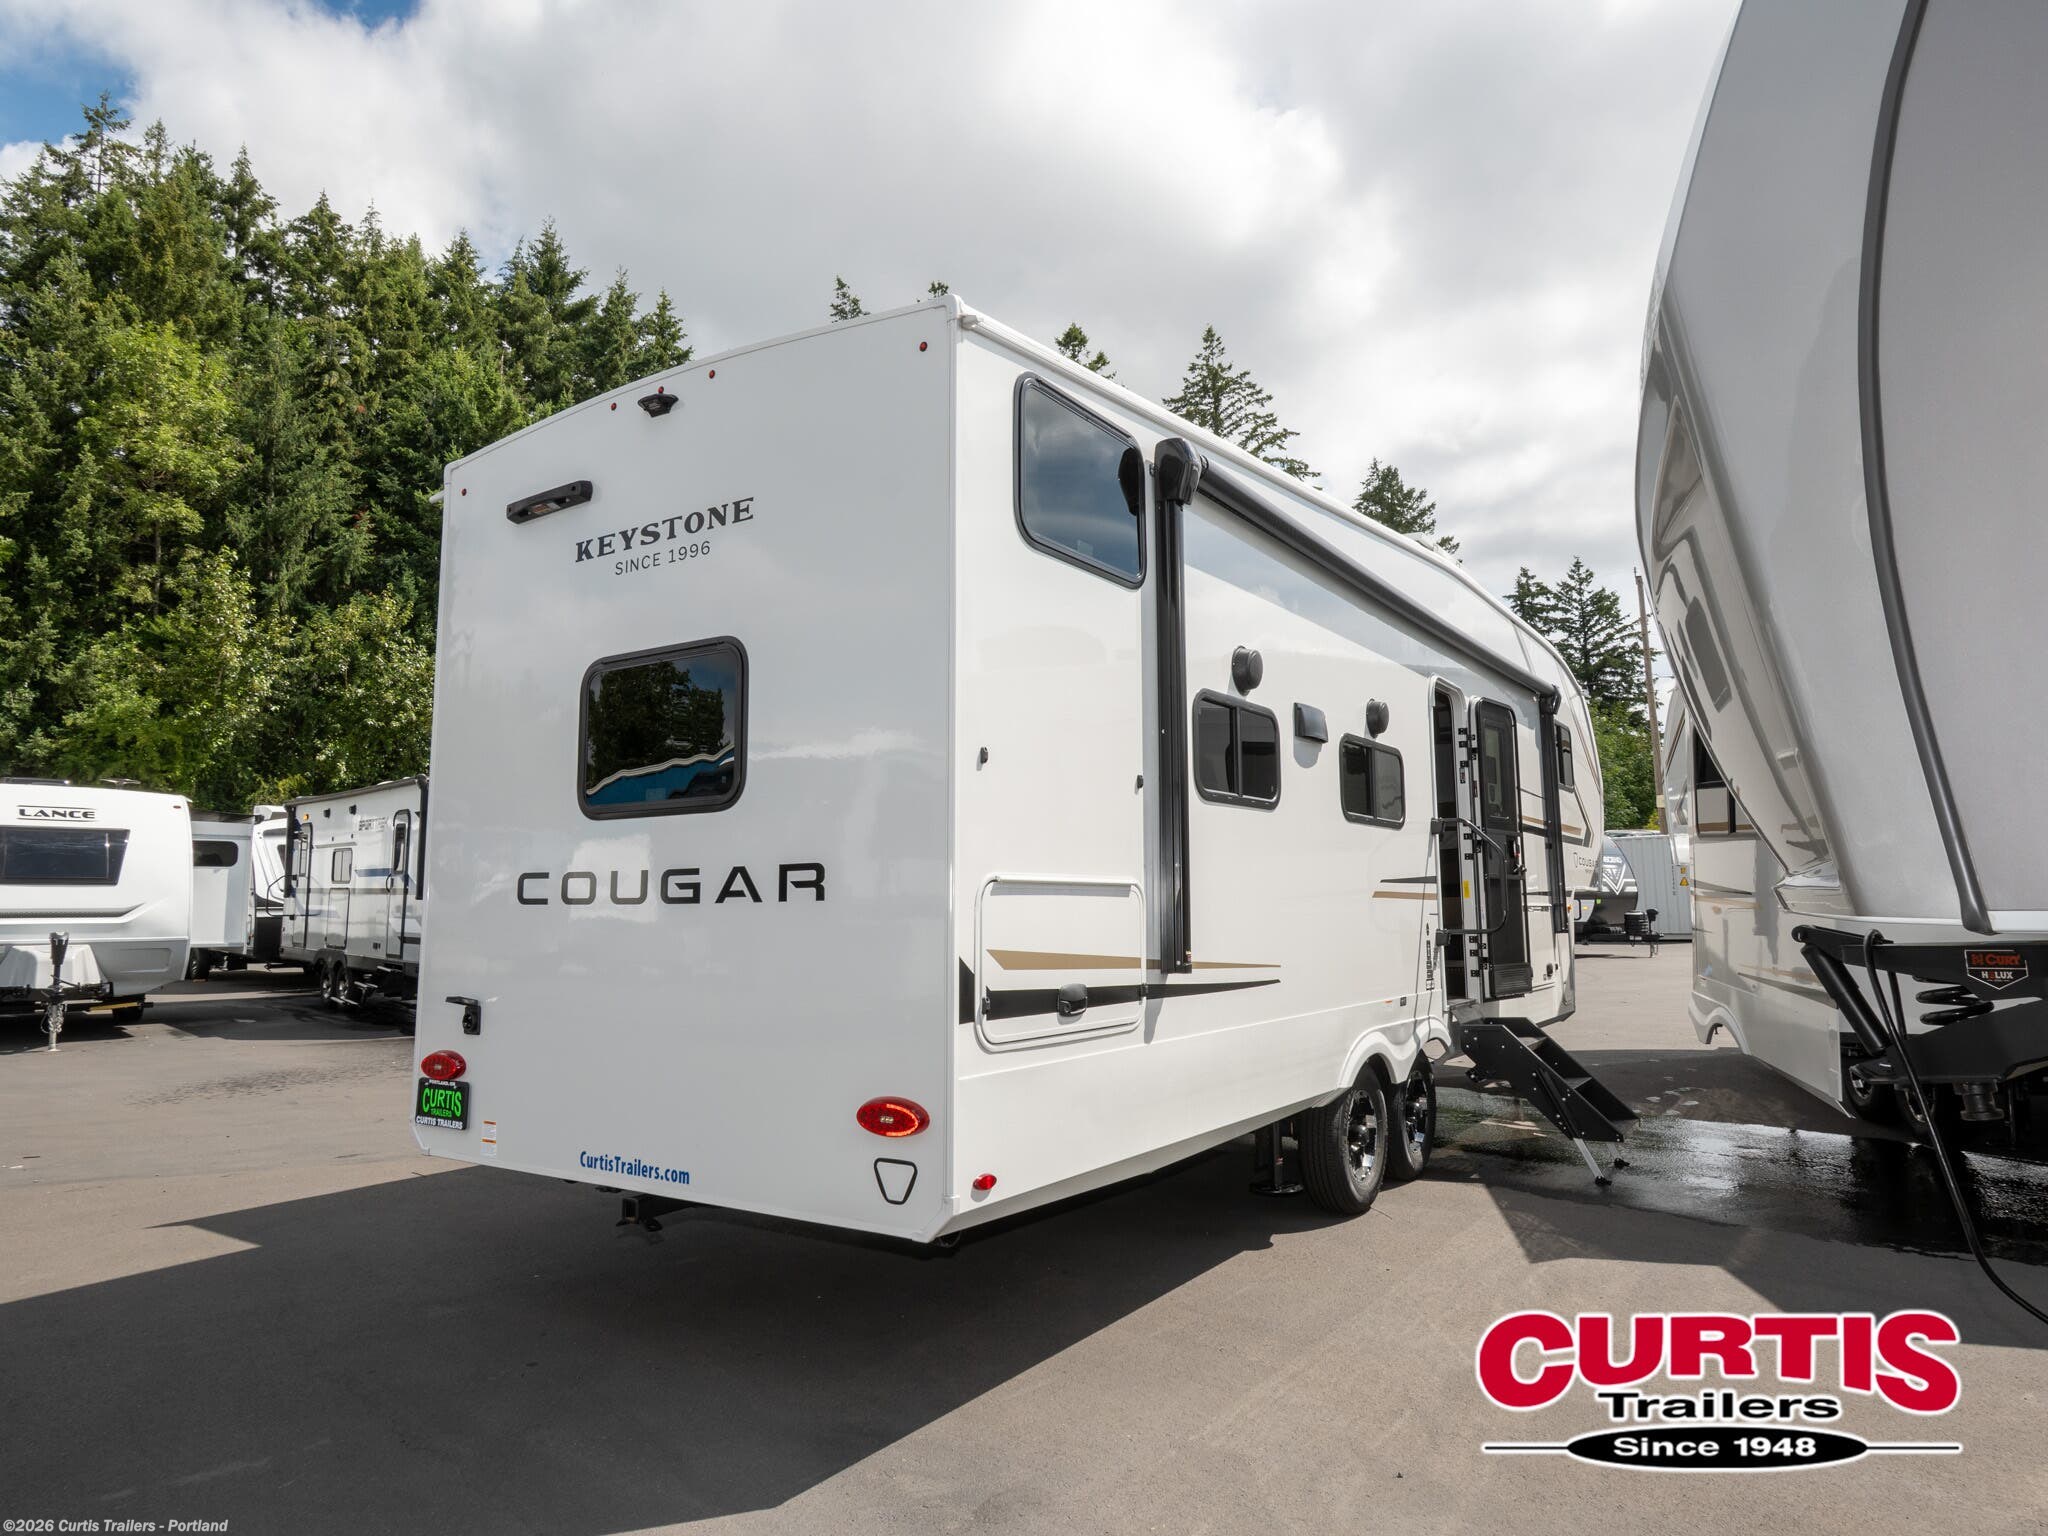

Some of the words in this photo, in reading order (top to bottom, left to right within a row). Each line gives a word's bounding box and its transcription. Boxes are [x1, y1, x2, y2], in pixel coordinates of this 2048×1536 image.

[575, 497, 754, 562] KEYSTONE
[615, 552, 661, 576] SINCE
[668, 541, 711, 564] 1996
[19, 808, 95, 819] LANCE
[517, 862, 826, 906] COUGAR
[422, 1087, 462, 1117] CURTIS
[430, 1108, 452, 1117] TRAILERS
[416, 1115, 436, 1125] CURTIS
[437, 1118, 463, 1130] TRAILERS
[580, 1151, 690, 1185] CurtisTrailers.com
